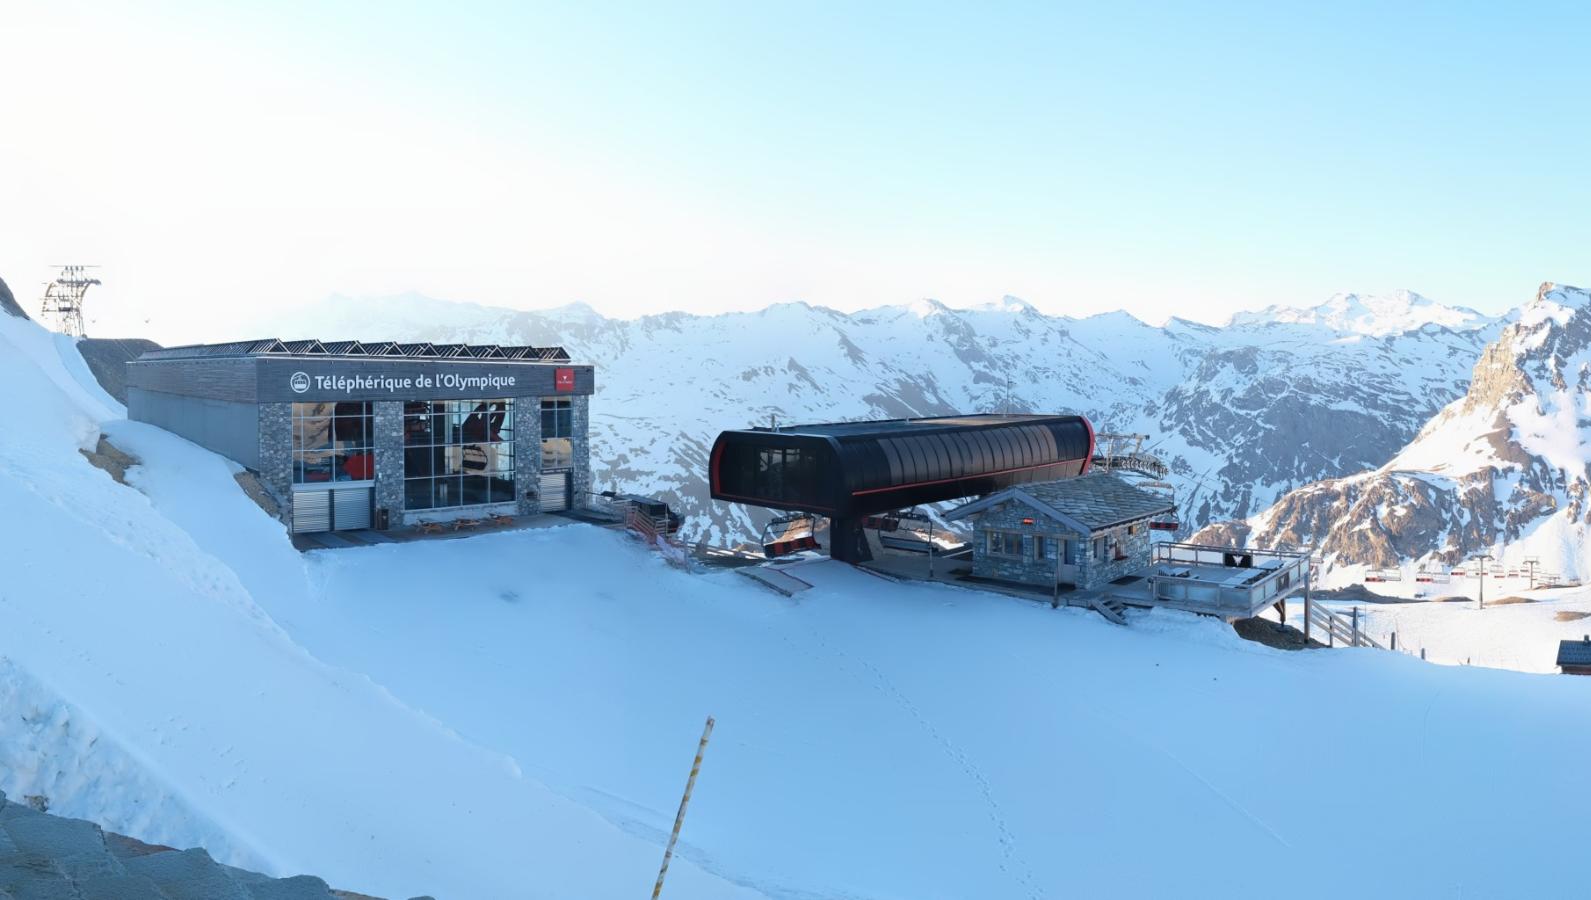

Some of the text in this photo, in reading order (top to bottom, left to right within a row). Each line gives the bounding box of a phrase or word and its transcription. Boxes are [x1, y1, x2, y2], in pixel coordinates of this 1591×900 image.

[314, 373, 516, 393] Téléphérique de l'Olympique
